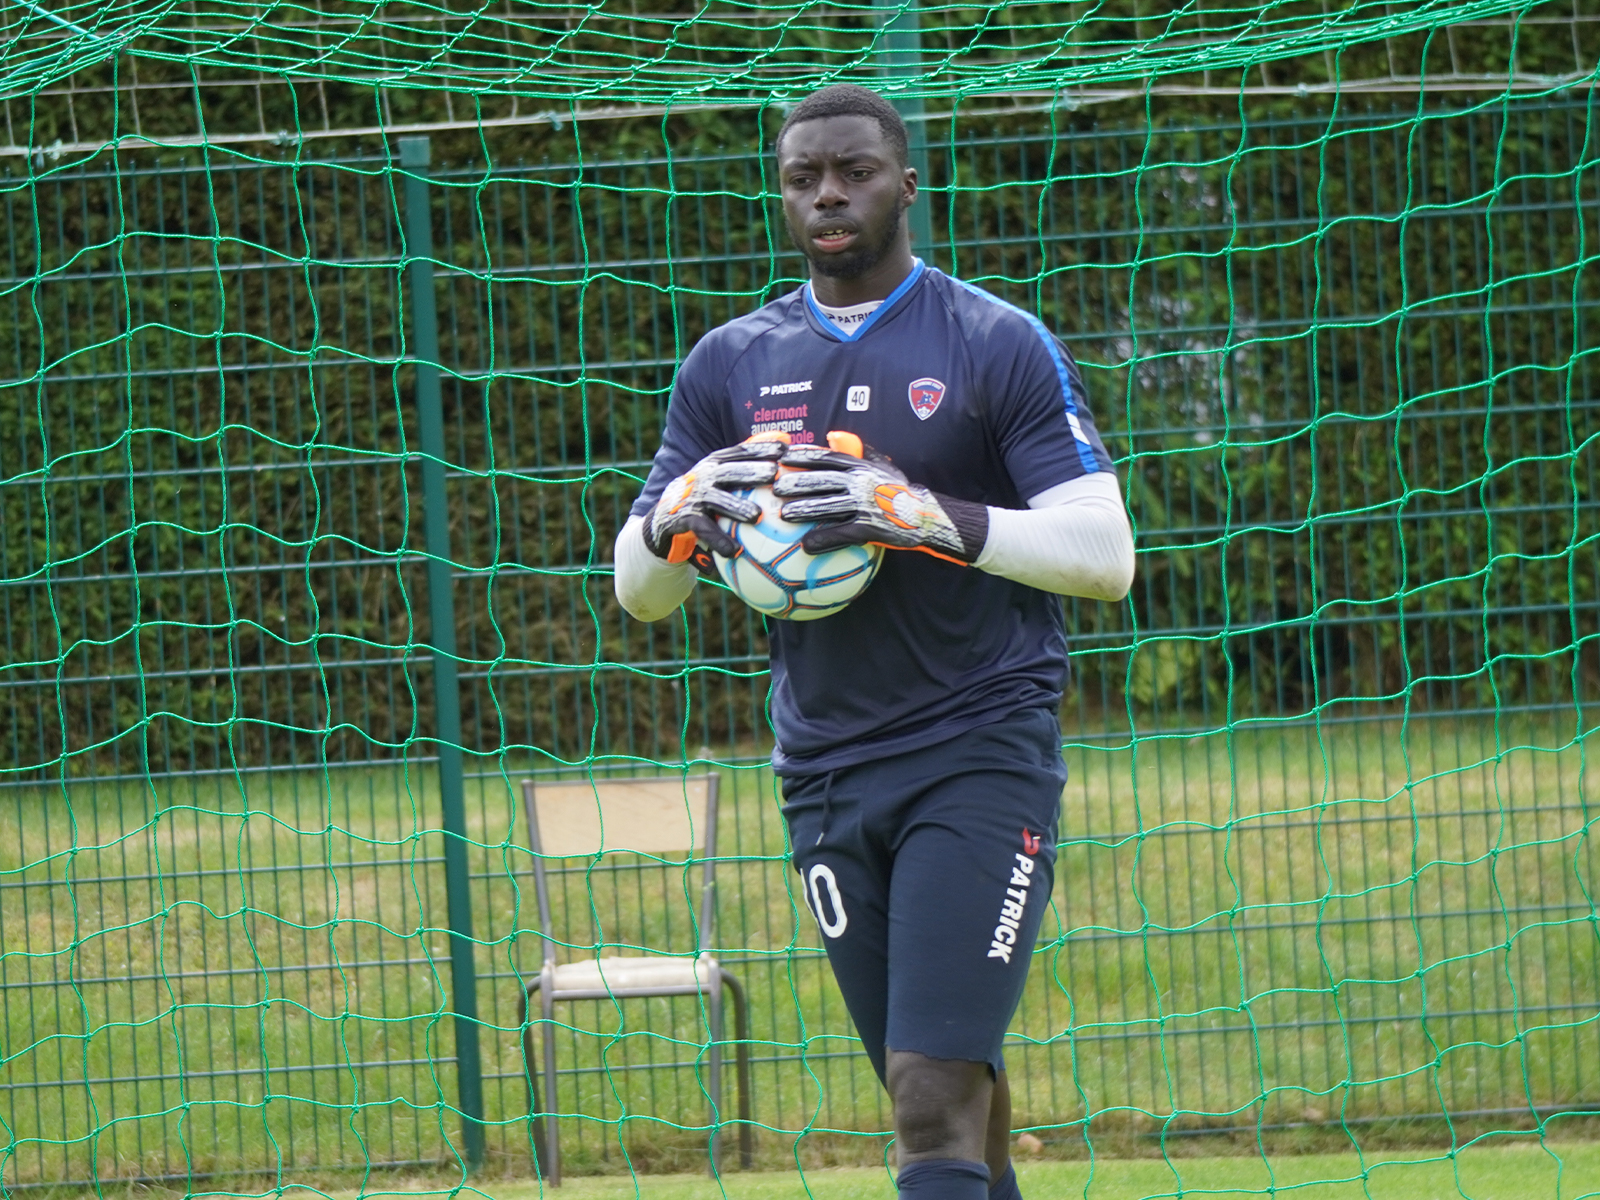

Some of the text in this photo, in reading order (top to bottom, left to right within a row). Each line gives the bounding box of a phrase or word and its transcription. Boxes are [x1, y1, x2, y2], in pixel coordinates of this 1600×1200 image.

[771, 380, 813, 395] PATRICK
[851, 390, 866, 406] 40
[754, 403, 808, 422] clermont
[751, 419, 804, 436] auvergne
[800, 863, 848, 938] 0
[987, 852, 1034, 964] PATRICK
